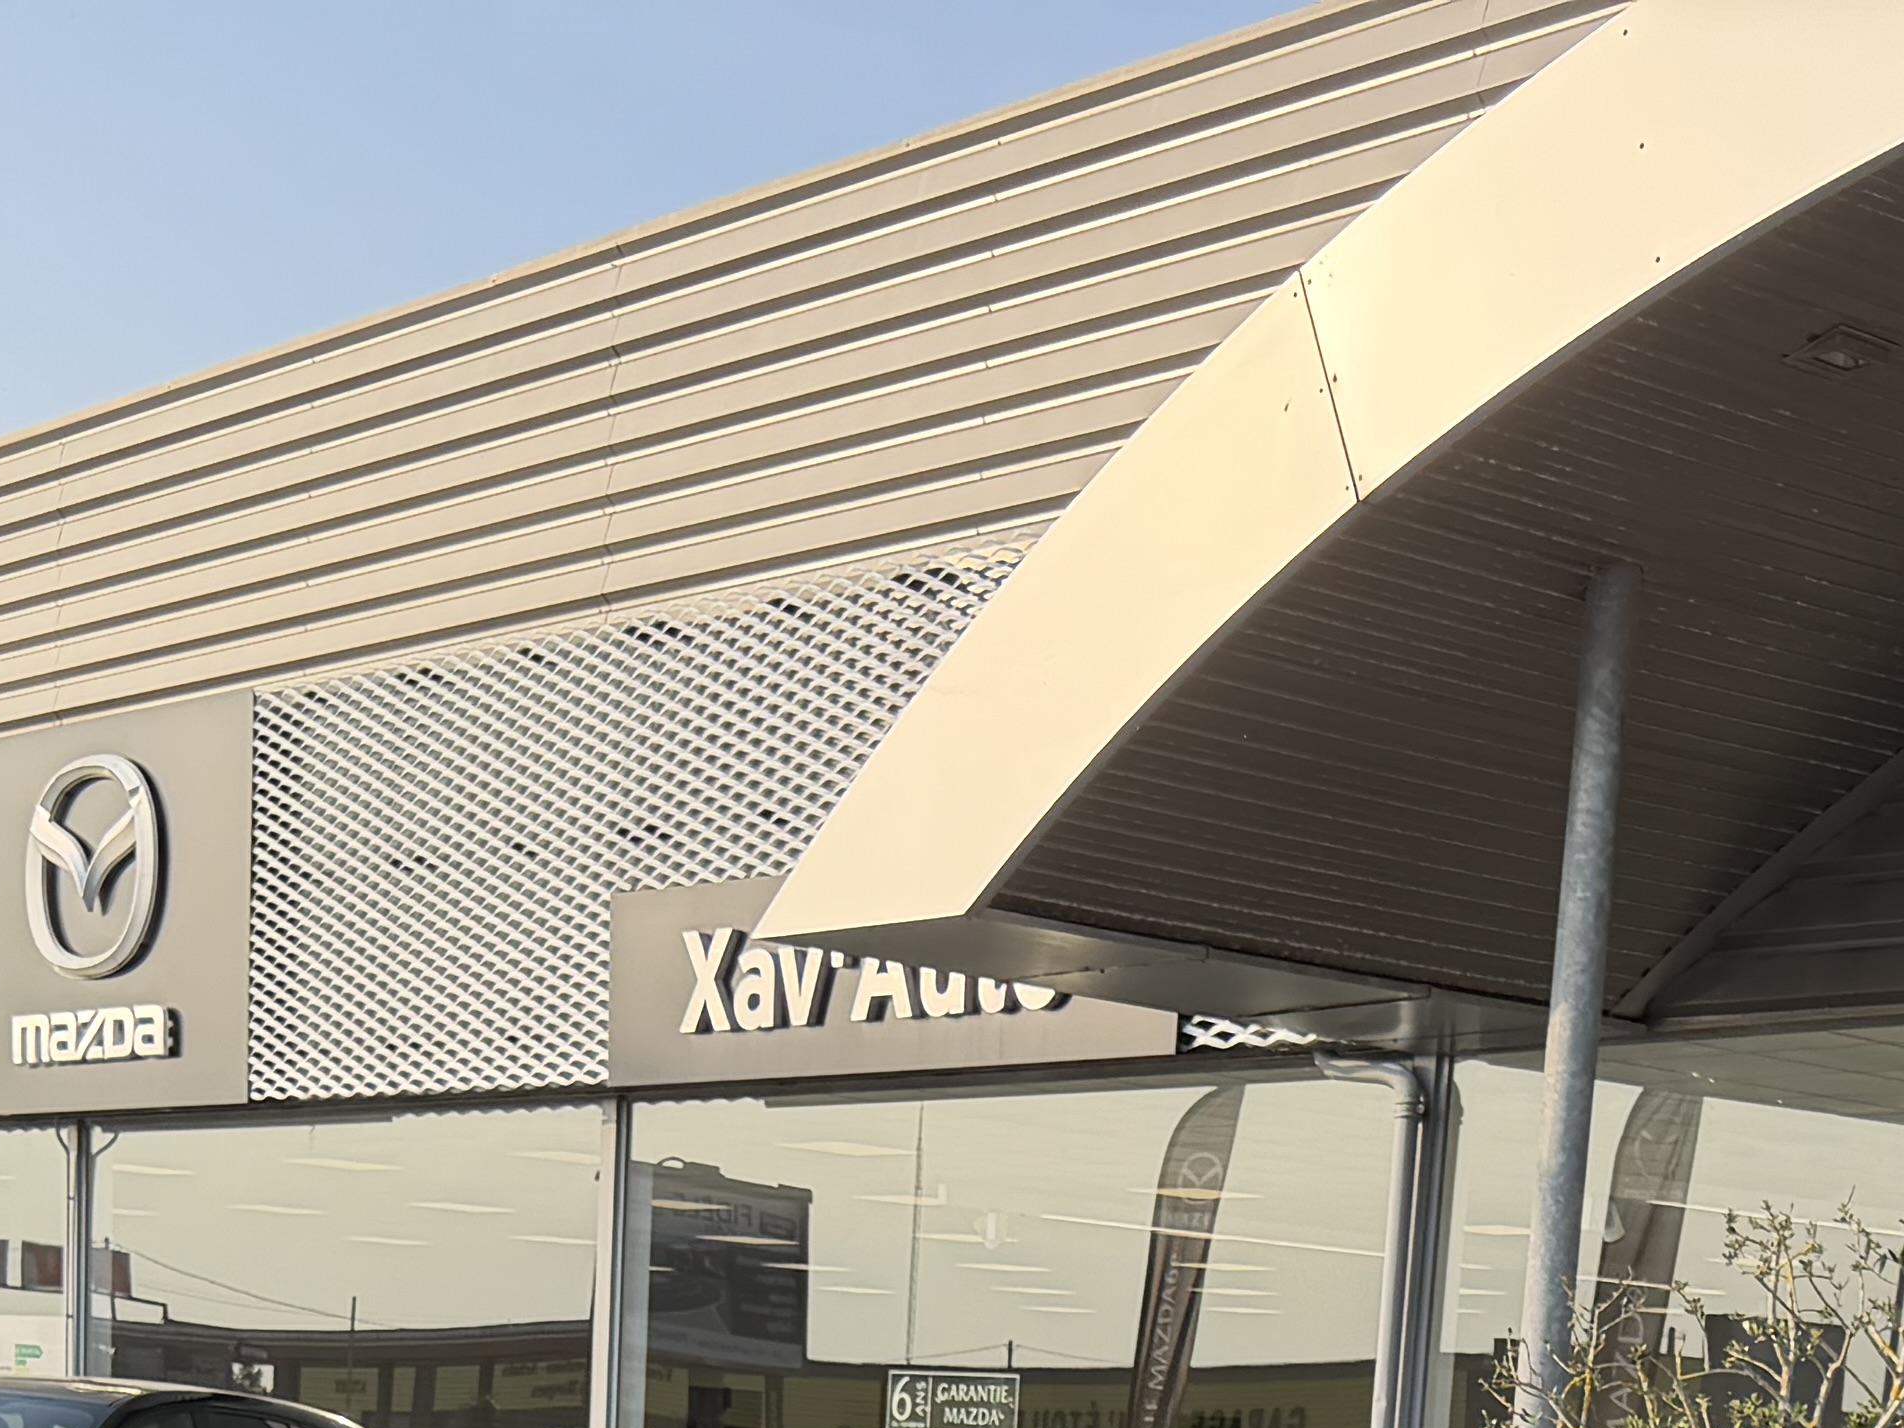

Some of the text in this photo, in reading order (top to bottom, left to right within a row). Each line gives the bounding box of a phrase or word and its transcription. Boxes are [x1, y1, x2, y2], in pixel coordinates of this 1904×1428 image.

[12, 1004, 166, 1065] mazda
[892, 1376, 927, 1421] 6 ANS
[937, 1383, 1009, 1404] GARANTIE
[943, 1406, 1000, 1426] MAZDA
